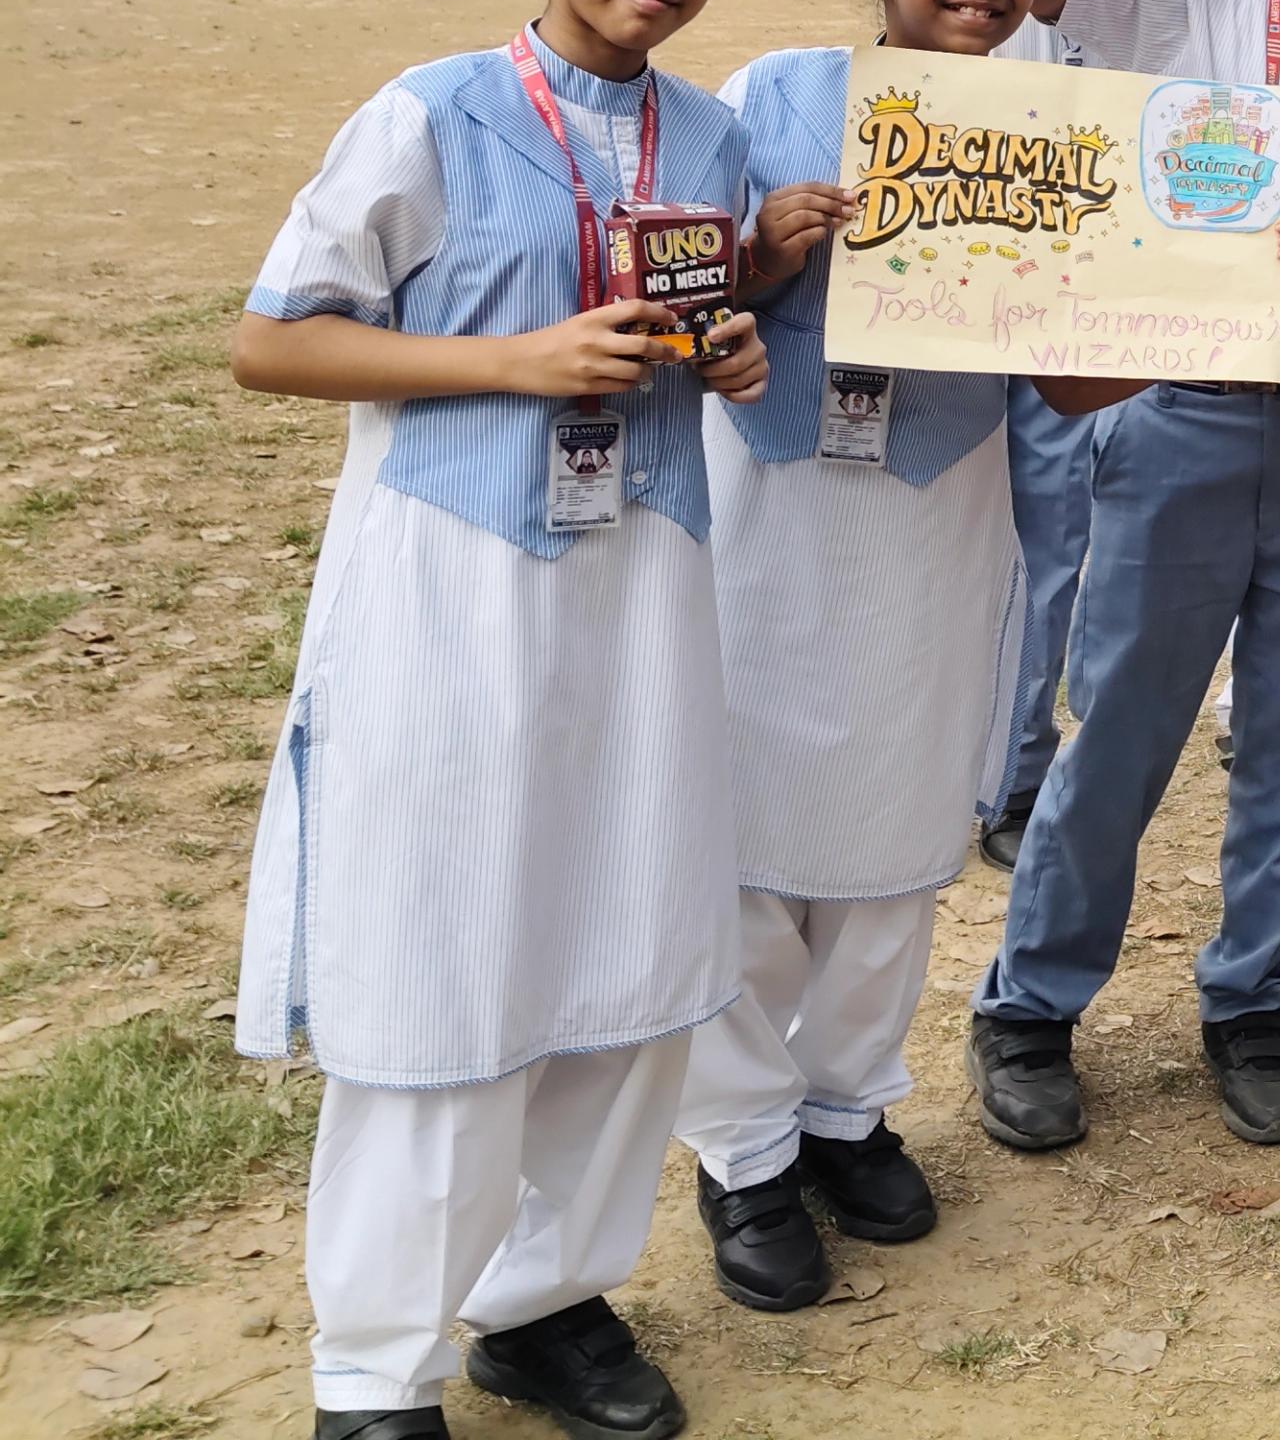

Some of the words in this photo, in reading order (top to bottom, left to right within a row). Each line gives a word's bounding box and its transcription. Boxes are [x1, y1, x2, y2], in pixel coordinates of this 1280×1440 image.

[643, 158, 656, 185] AMRITA
[857, 112, 1117, 201] DECIMAL
[1155, 151, 1265, 183] Decimal
[844, 177, 1111, 251] DYNASTY
[584, 221, 596, 275] VIDYALAYAM
[615, 228, 633, 273] UNO
[645, 224, 723, 268] UNO
[646, 273, 671, 294] NO
[675, 264, 727, 289] MERCY
[852, 280, 975, 329] Tools
[988, 286, 1048, 351] for
[1029, 344, 1224, 373] WIZARDS!
[845, 373, 886, 383] AMRITA
[572, 425, 615, 435] AMRITA
